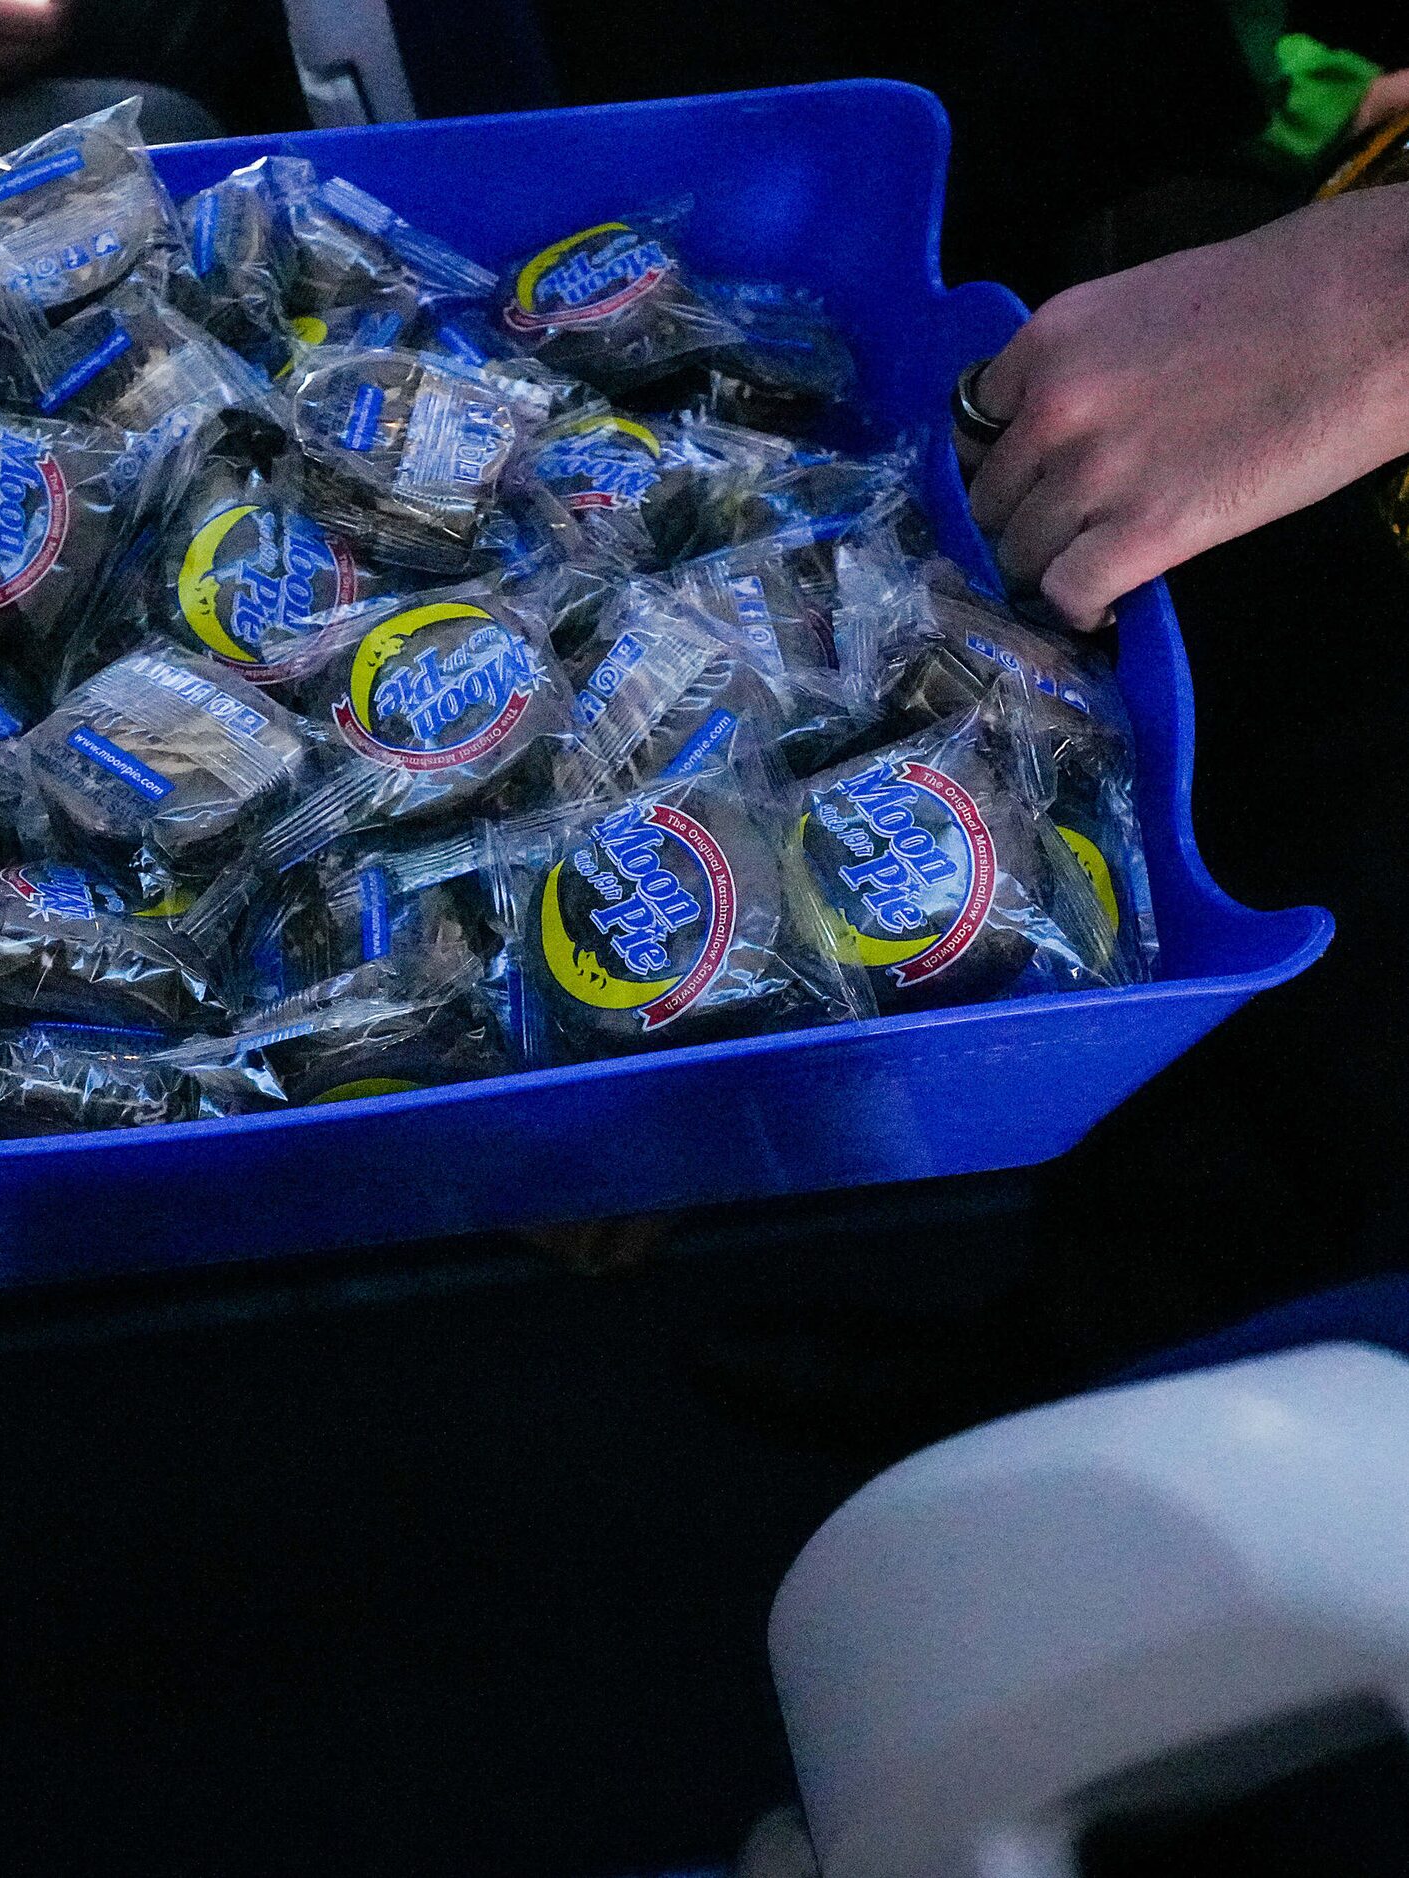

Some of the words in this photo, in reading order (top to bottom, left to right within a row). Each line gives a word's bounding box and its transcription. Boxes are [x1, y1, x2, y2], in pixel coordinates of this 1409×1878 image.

[231, 561, 281, 643] Pie
[374, 646, 441, 720] Pie
[408, 636, 532, 741] Moon
[74, 732, 164, 797] www.moonpie.com
[922, 771, 944, 790] The
[667, 814, 687, 832] The
[836, 764, 959, 889] Moon
[837, 828, 875, 858] 1917
[944, 787, 982, 833] Original
[587, 871, 623, 901] 1917
[591, 806, 702, 934] Moon
[688, 829, 723, 877] Original
[968, 833, 991, 921] Marshmallow
[708, 874, 731, 960] Marshmallow
[839, 850, 924, 934] Pie
[590, 892, 668, 976] Pie
[921, 923, 973, 969] Sandwich
[664, 963, 714, 1011] Sandwich
